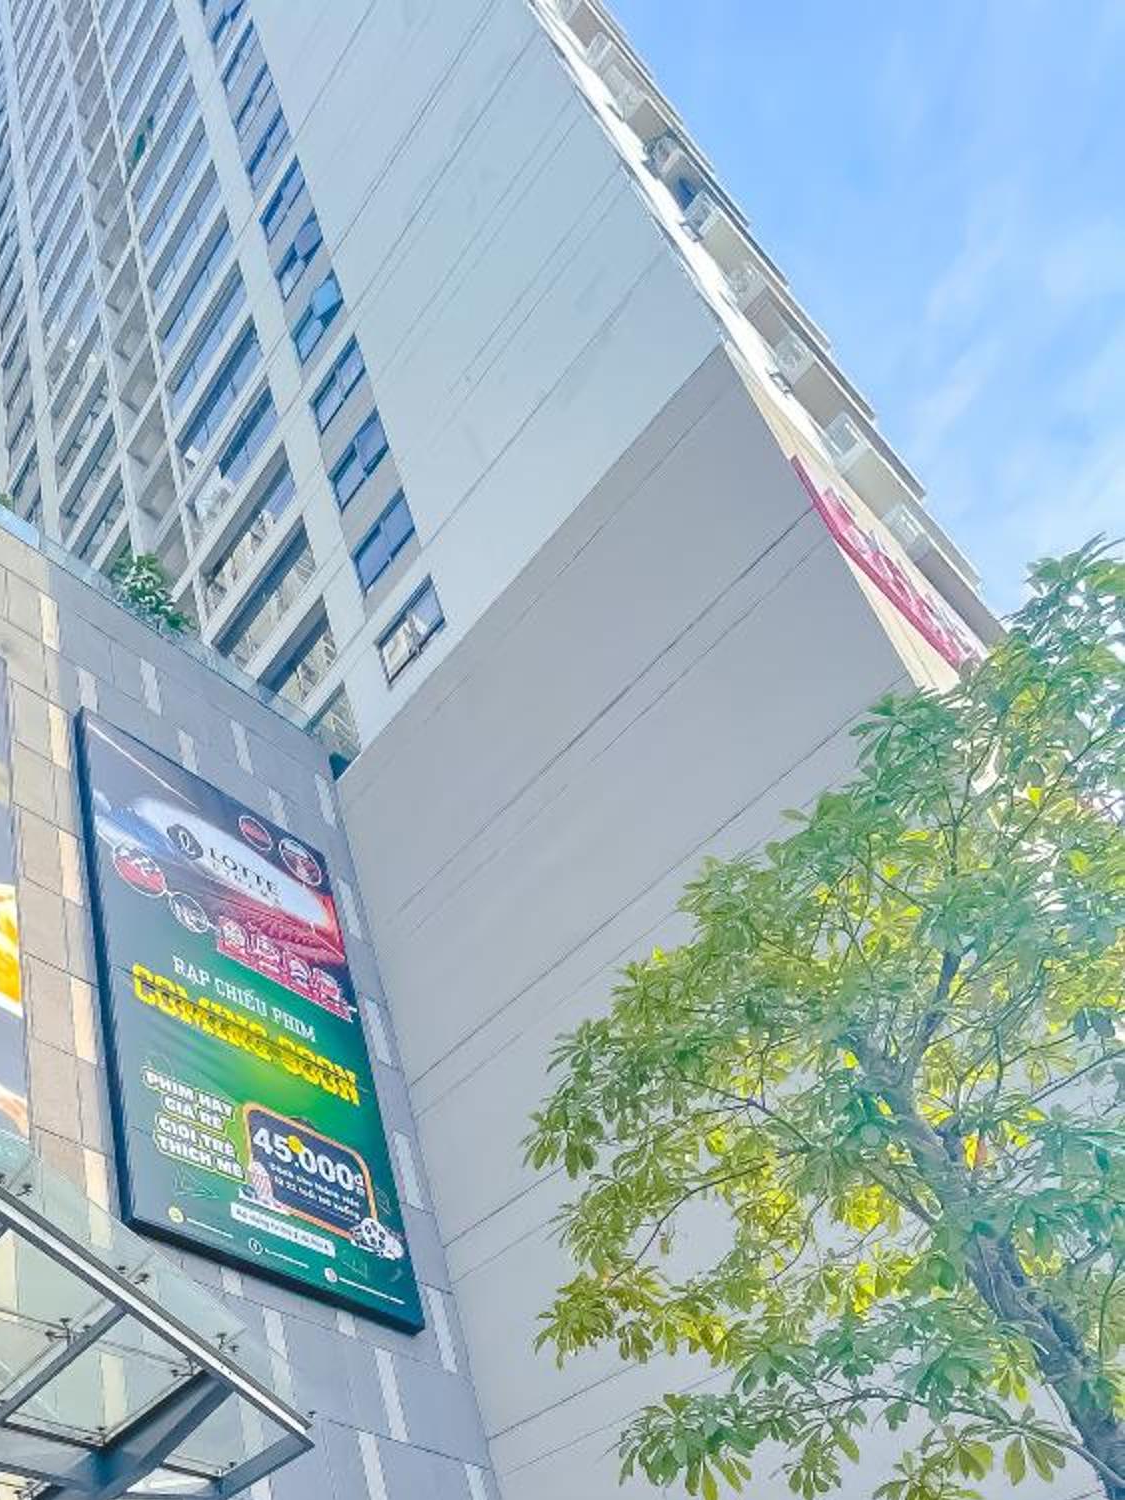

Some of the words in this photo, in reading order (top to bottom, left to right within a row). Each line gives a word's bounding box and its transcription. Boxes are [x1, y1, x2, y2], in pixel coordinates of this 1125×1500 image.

[209, 847, 281, 893] LOTTE
[214, 978, 268, 1018] CHIẾU
[271, 1007, 317, 1043] PHIM
[145, 1070, 195, 1102] PHIM
[198, 1092, 234, 1118] HAY
[277, 1034, 361, 1107] SOON
